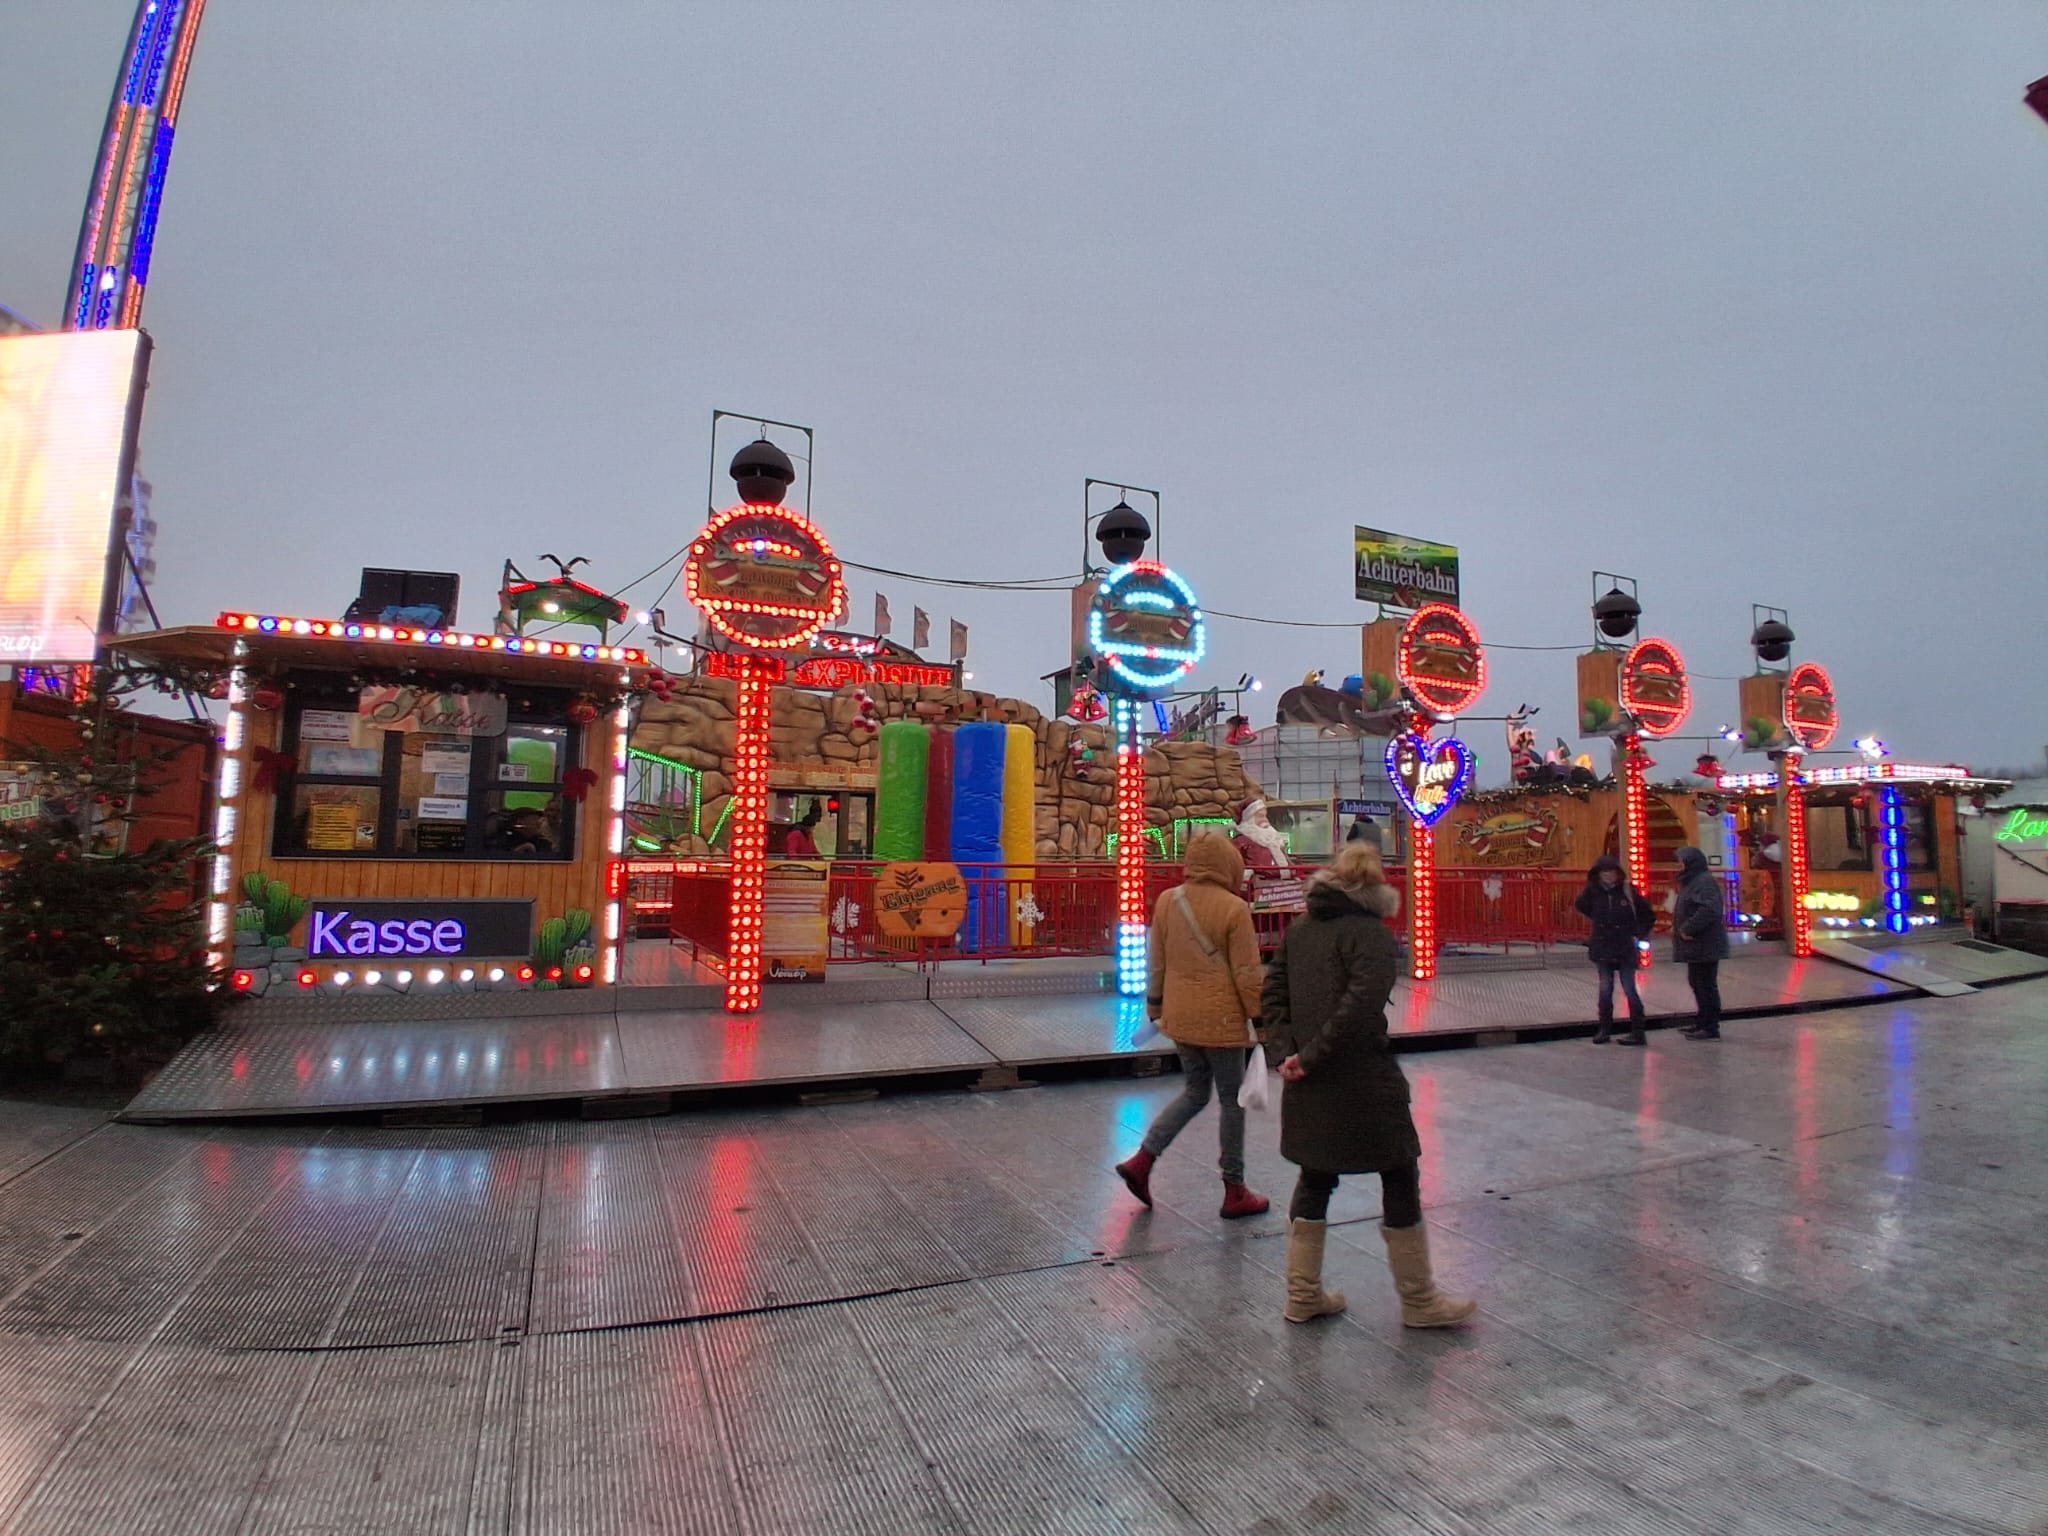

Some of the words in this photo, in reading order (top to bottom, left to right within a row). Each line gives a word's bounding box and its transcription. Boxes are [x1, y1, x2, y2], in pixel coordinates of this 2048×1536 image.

[1358, 550, 1457, 595] Achterbahn
[796, 658, 954, 688] EXPLOSIVE
[1341, 801, 1391, 814] Achterbahn
[880, 876, 960, 912] Eingang
[311, 911, 465, 955] Kasse
